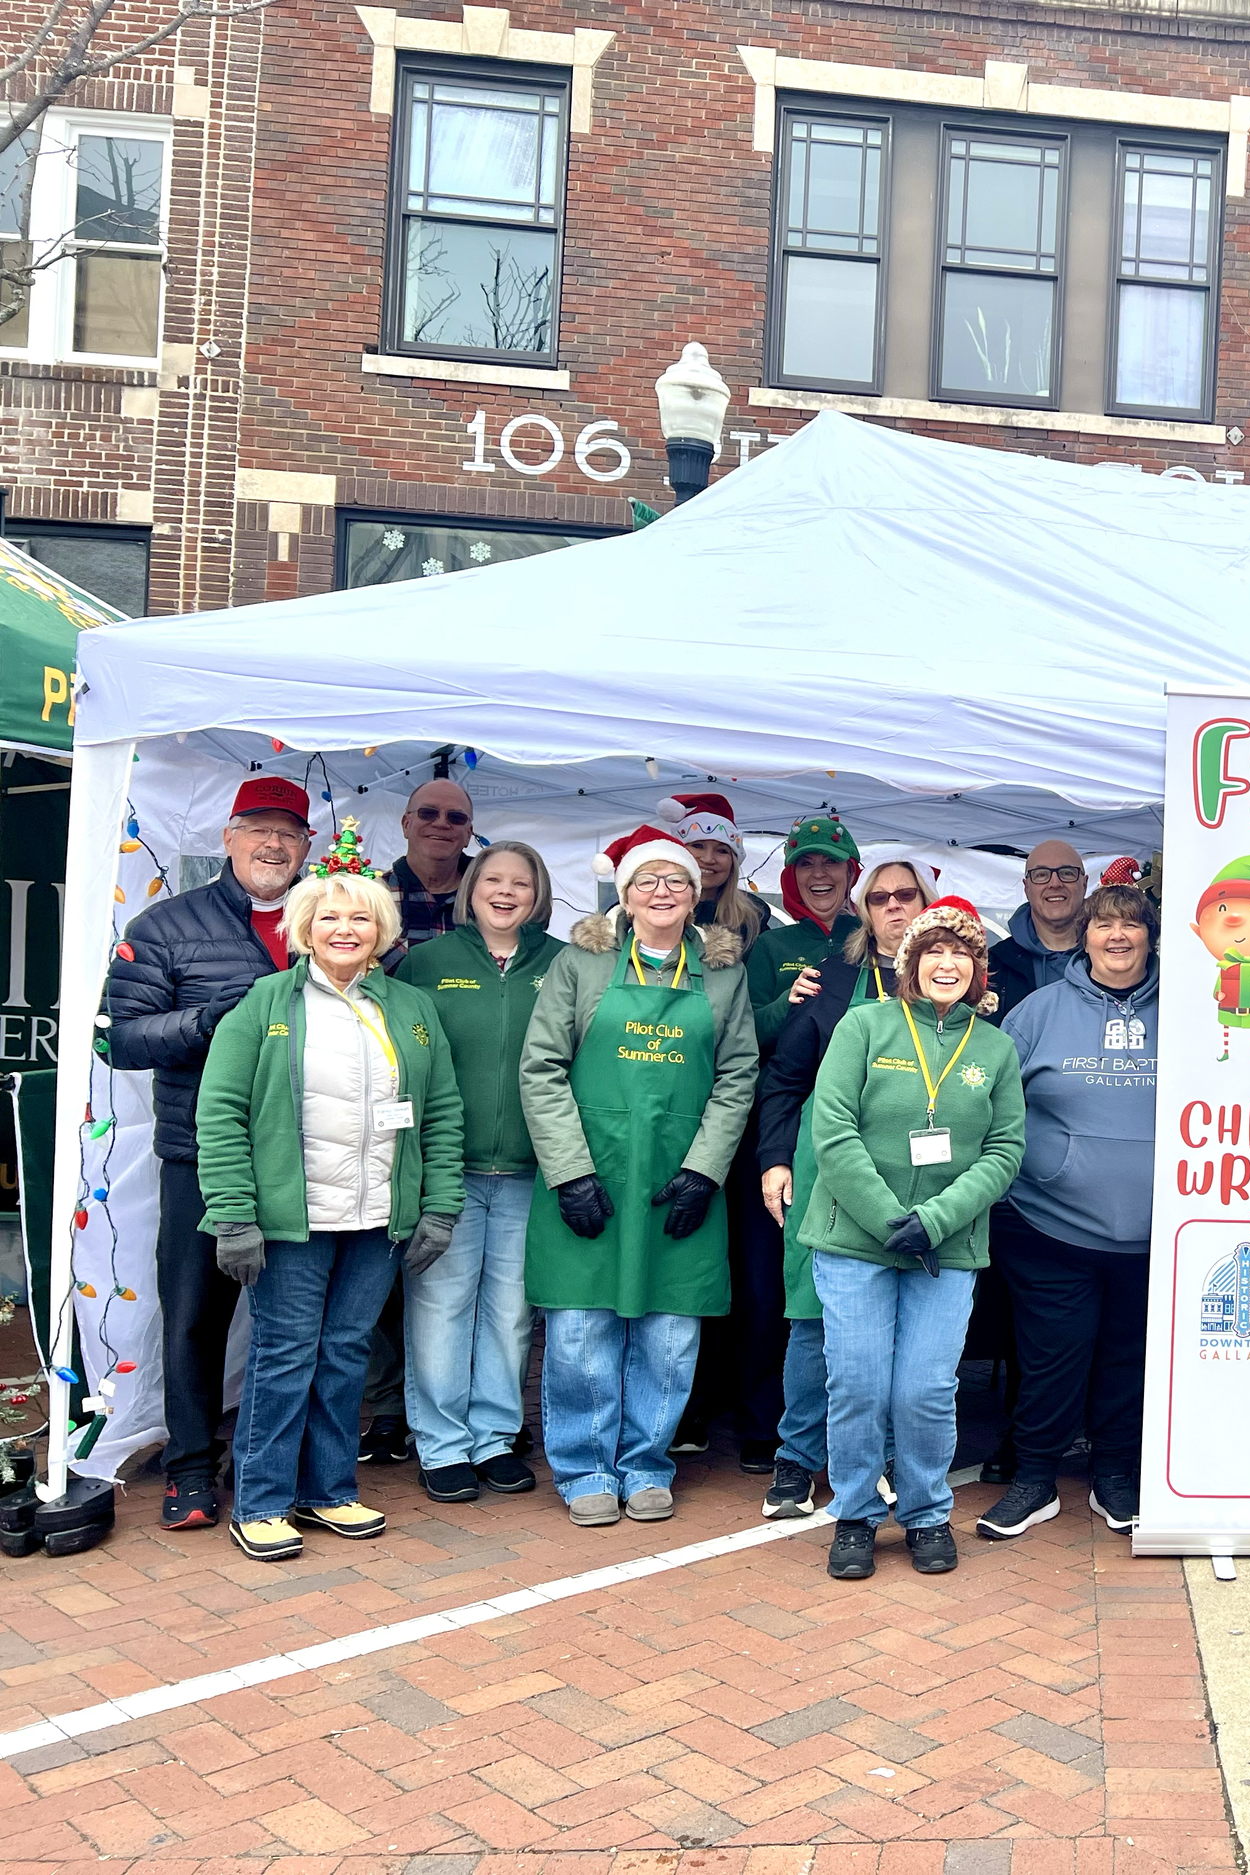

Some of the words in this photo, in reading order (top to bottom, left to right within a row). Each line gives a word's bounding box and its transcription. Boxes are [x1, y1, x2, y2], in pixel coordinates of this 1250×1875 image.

[462, 409, 631, 482] 106
[625, 1021, 654, 1036] Pilot
[656, 1024, 684, 1038] Club
[647, 1039, 662, 1051] of
[617, 1046, 666, 1063] Sumner
[668, 1051, 685, 1064] Co.
[877, 1056, 893, 1064] Pilot
[893, 1058, 907, 1066] Club
[872, 1062, 896, 1070] Sumner
[896, 1065, 918, 1074] County
[1062, 1057, 1109, 1070] FIRST
[1085, 1075, 1155, 1087] GALLATIN
[1240, 1260, 1250, 1329] HISTORIC
